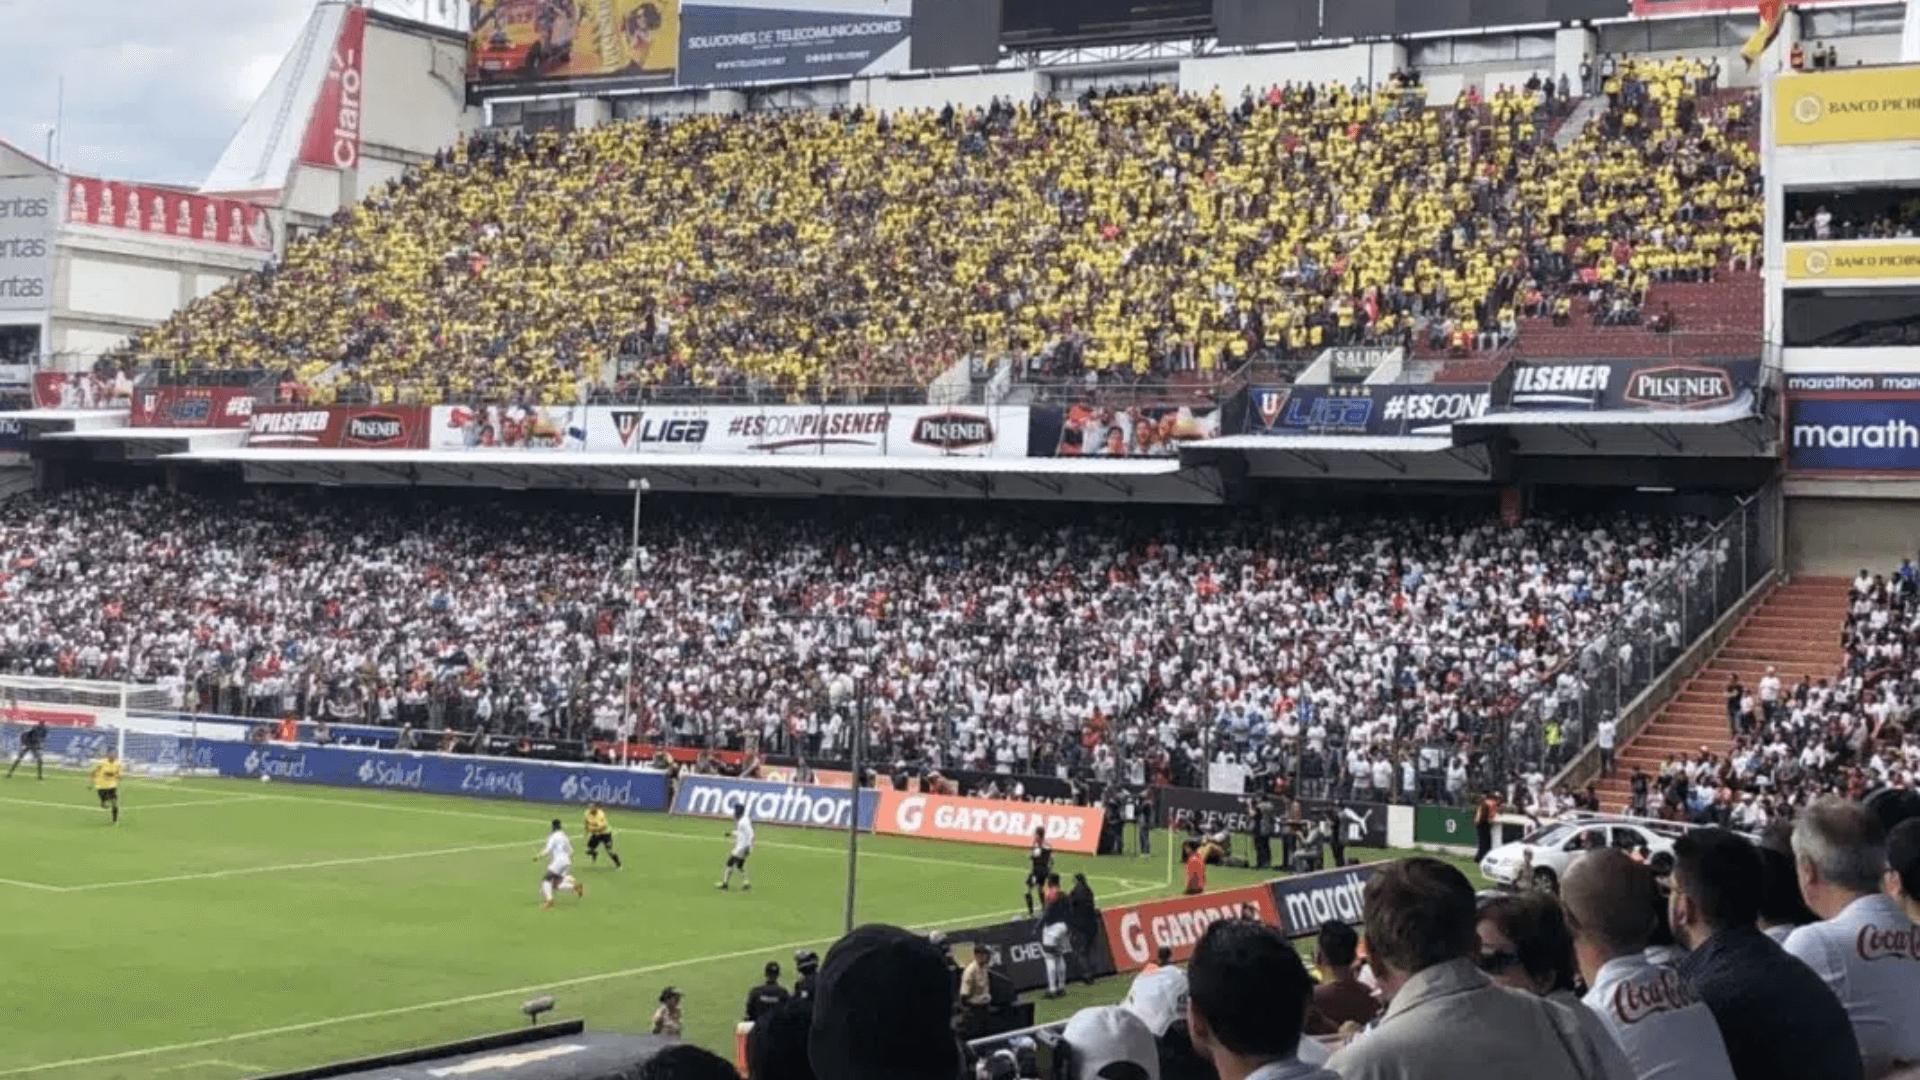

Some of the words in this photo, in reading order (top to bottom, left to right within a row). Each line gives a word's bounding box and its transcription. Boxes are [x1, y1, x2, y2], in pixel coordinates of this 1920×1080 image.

[688, 31, 757, 50] SOLUCIONES
[758, 30, 774, 43] DE
[775, 20, 902, 42] TELECOMUNICACIONES
[1828, 99, 1880, 114] BANCO
[1835, 256, 1878, 268] BANCO
[1638, 374, 1724, 397] PILSENER
[1788, 375, 1875, 389] marathon
[921, 421, 986, 440] PILSENER
[1793, 419, 1919, 448] marath
[375, 759, 424, 788] Salud
[578, 775, 634, 805] Salud
[687, 784, 853, 827] marathon
[934, 804, 1085, 841] GATORADE
[1445, 818, 1457, 834] 9
